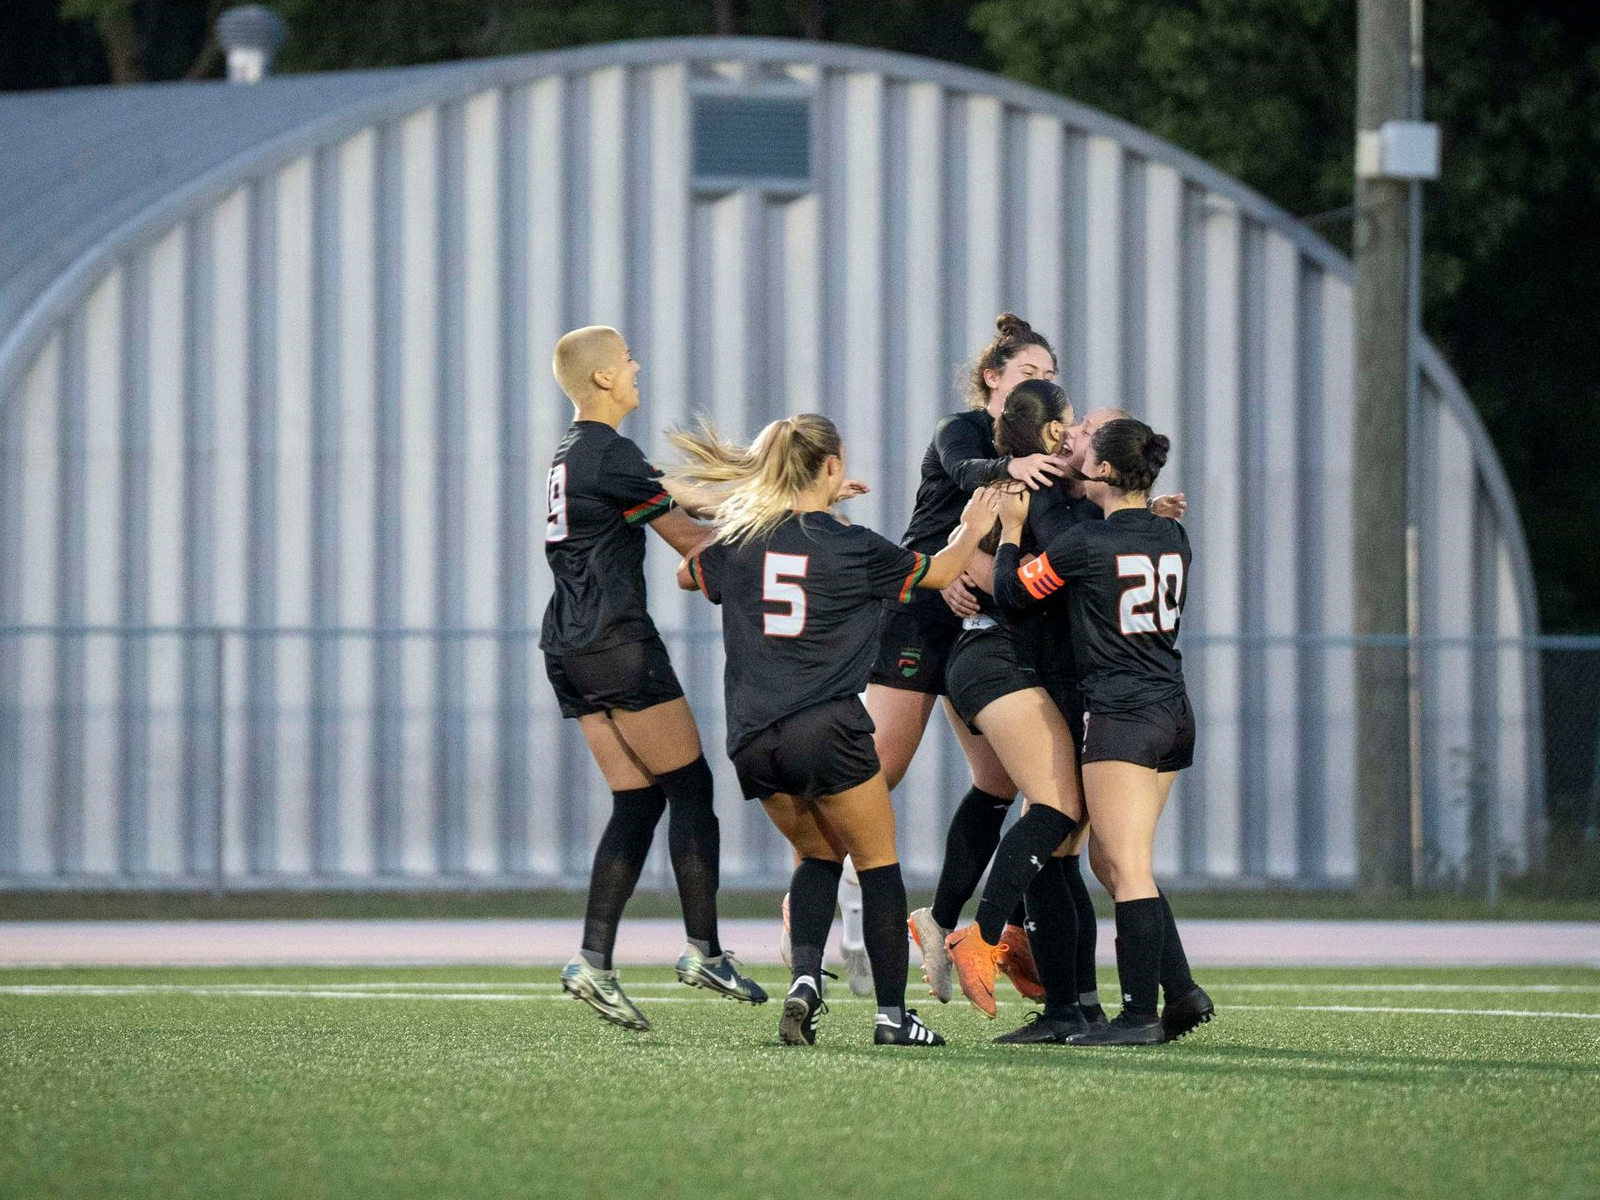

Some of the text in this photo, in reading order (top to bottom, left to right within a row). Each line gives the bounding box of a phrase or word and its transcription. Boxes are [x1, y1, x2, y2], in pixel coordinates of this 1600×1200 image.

[545, 462, 569, 543] 9
[762, 550, 810, 638] 5
[1022, 556, 1043, 578] C
[1115, 552, 1184, 635] 20
